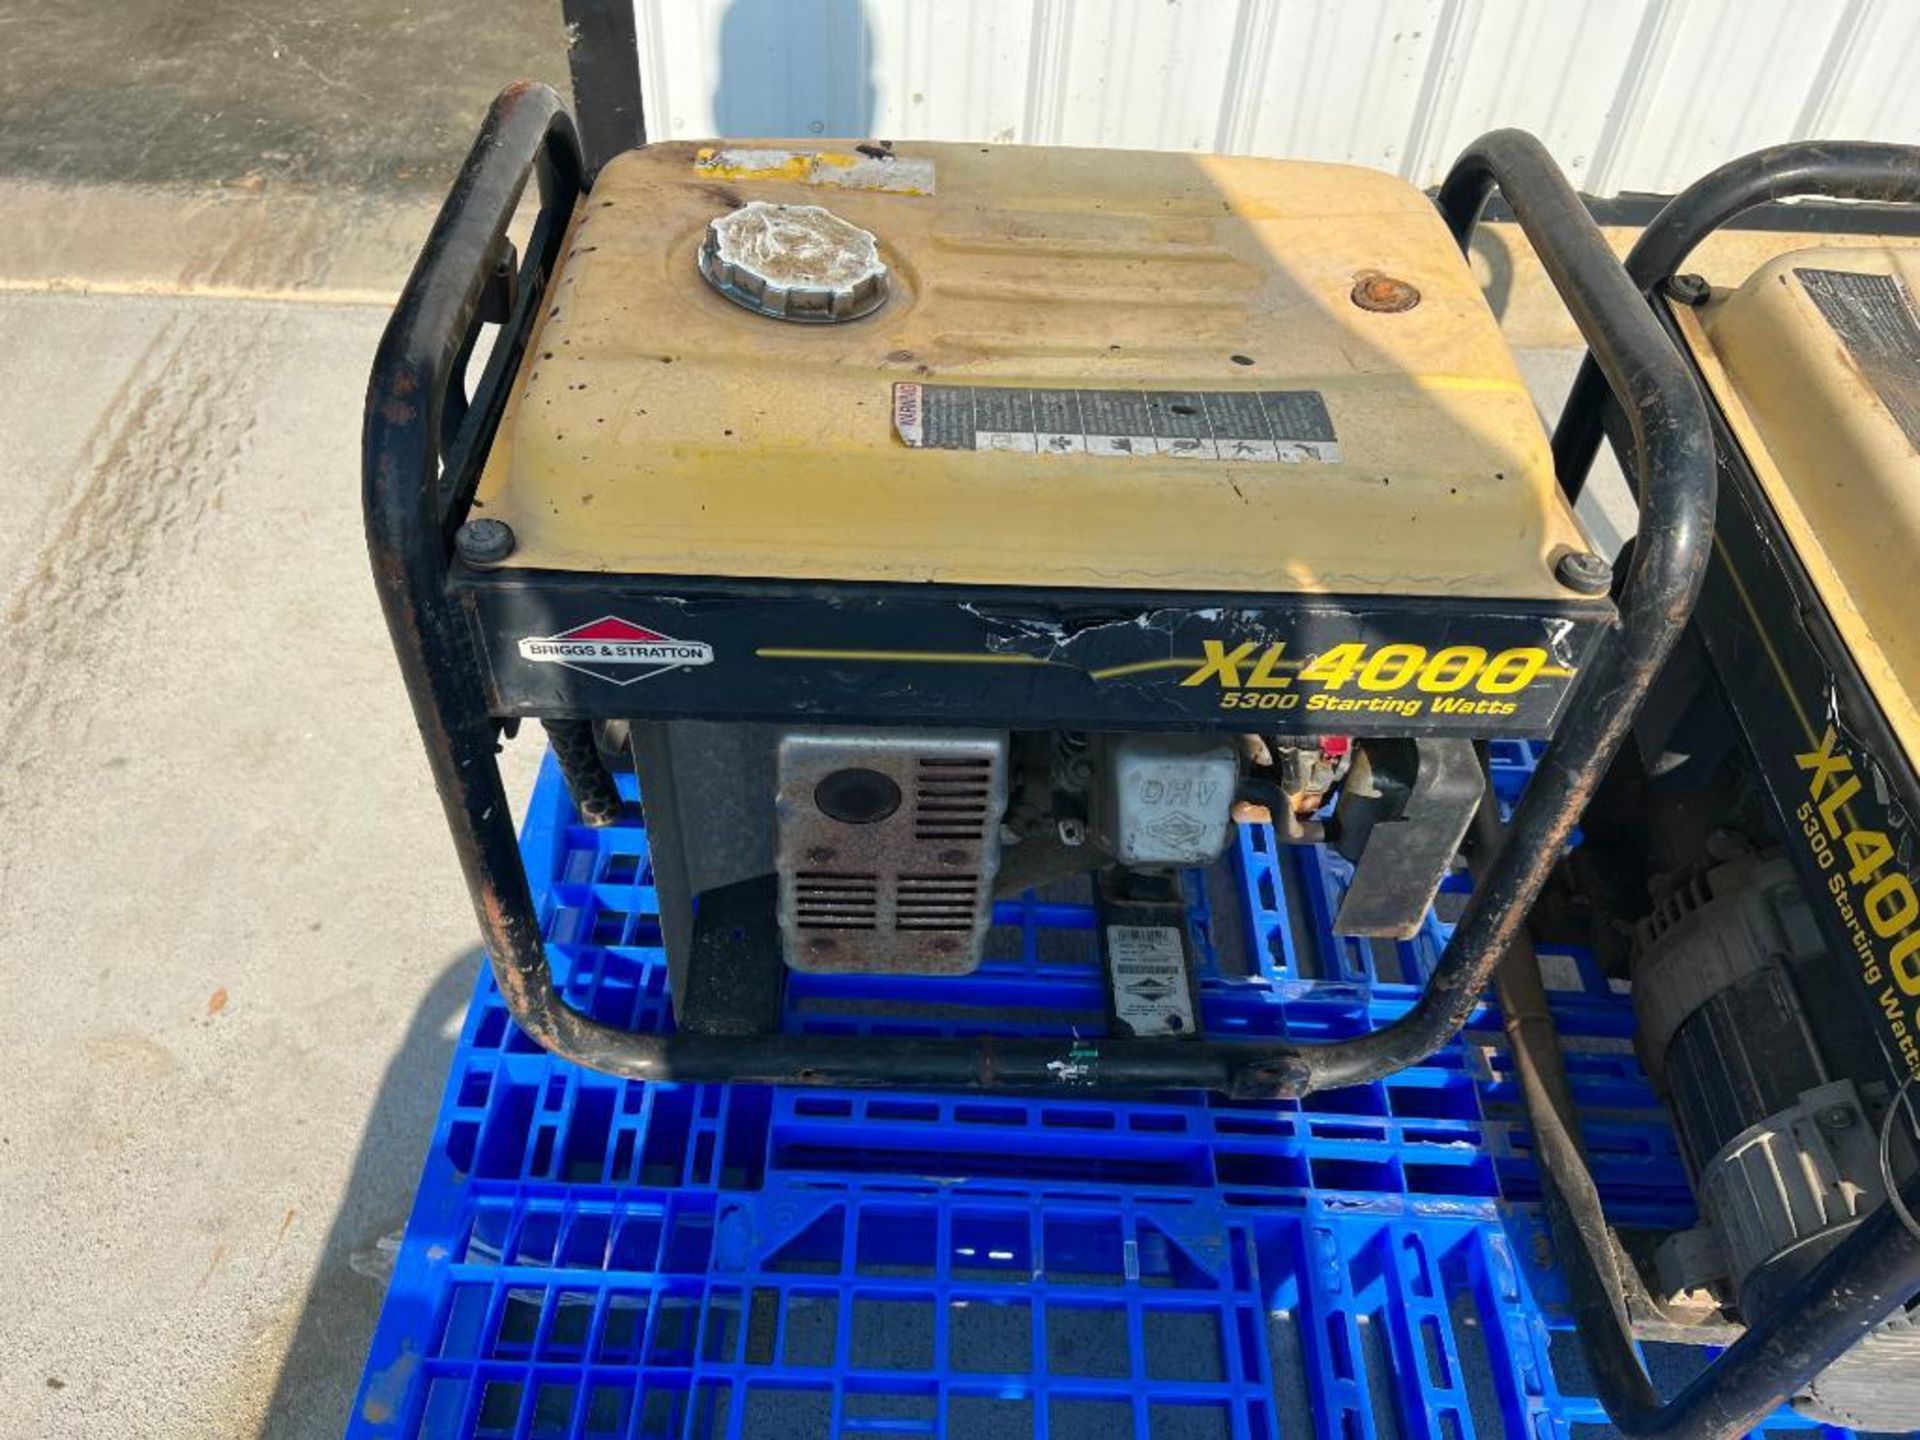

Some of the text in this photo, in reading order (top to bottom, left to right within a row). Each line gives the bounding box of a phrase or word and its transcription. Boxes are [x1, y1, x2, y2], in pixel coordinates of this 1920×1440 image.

[530, 644, 703, 659] BRIGGS & STRATTON
[1220, 692, 1517, 717] 5300 Starting Watts
[1140, 779, 1219, 806] OHV
[1797, 801, 1835, 870] 5300
[1828, 873, 1883, 985] Starting
